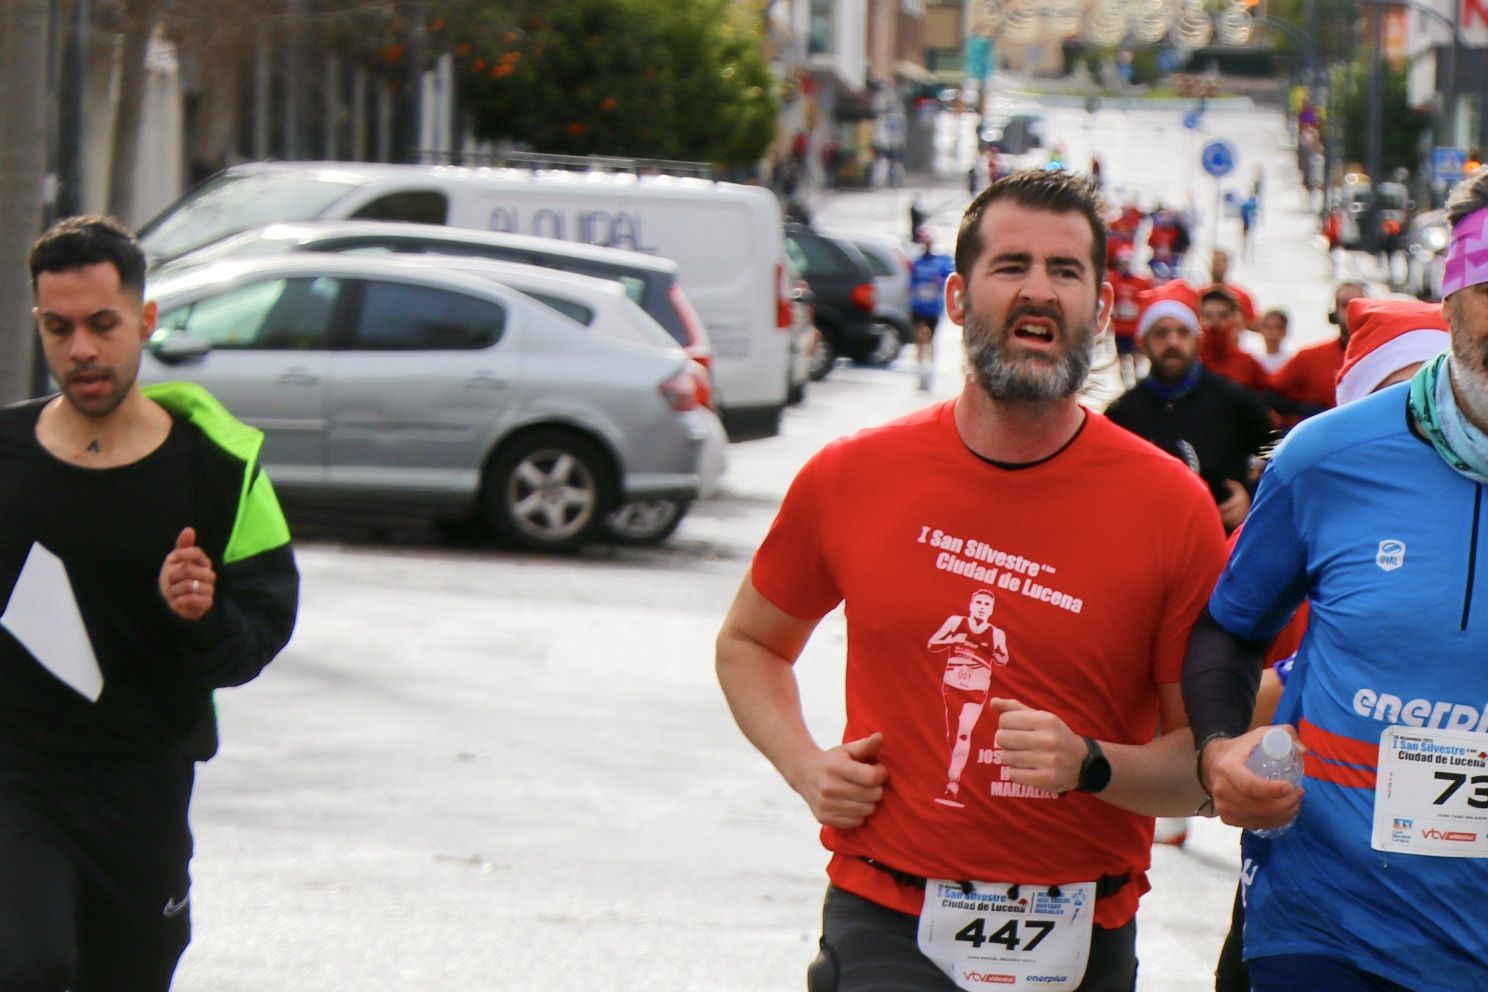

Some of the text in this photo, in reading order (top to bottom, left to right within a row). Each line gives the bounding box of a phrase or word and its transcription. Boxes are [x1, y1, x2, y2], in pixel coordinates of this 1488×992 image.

[917, 526, 931, 543] I
[930, 530, 964, 554] San
[964, 539, 1040, 577] Silvestre
[936, 552, 1084, 614] Ciudad de Lucena
[1400, 740, 1419, 751] San
[1421, 742, 1466, 756] Silvestre
[1398, 751, 1432, 763] Ciudad
[1435, 755, 1448, 765] de
[1450, 756, 1486, 768] Lucena
[944, 889, 965, 901] San
[942, 899, 976, 911] Ciudad
[977, 902, 989, 912] de
[991, 903, 1026, 914] Lucena
[955, 918, 1056, 951] 447
[1026, 975, 1067, 984] enerplus
